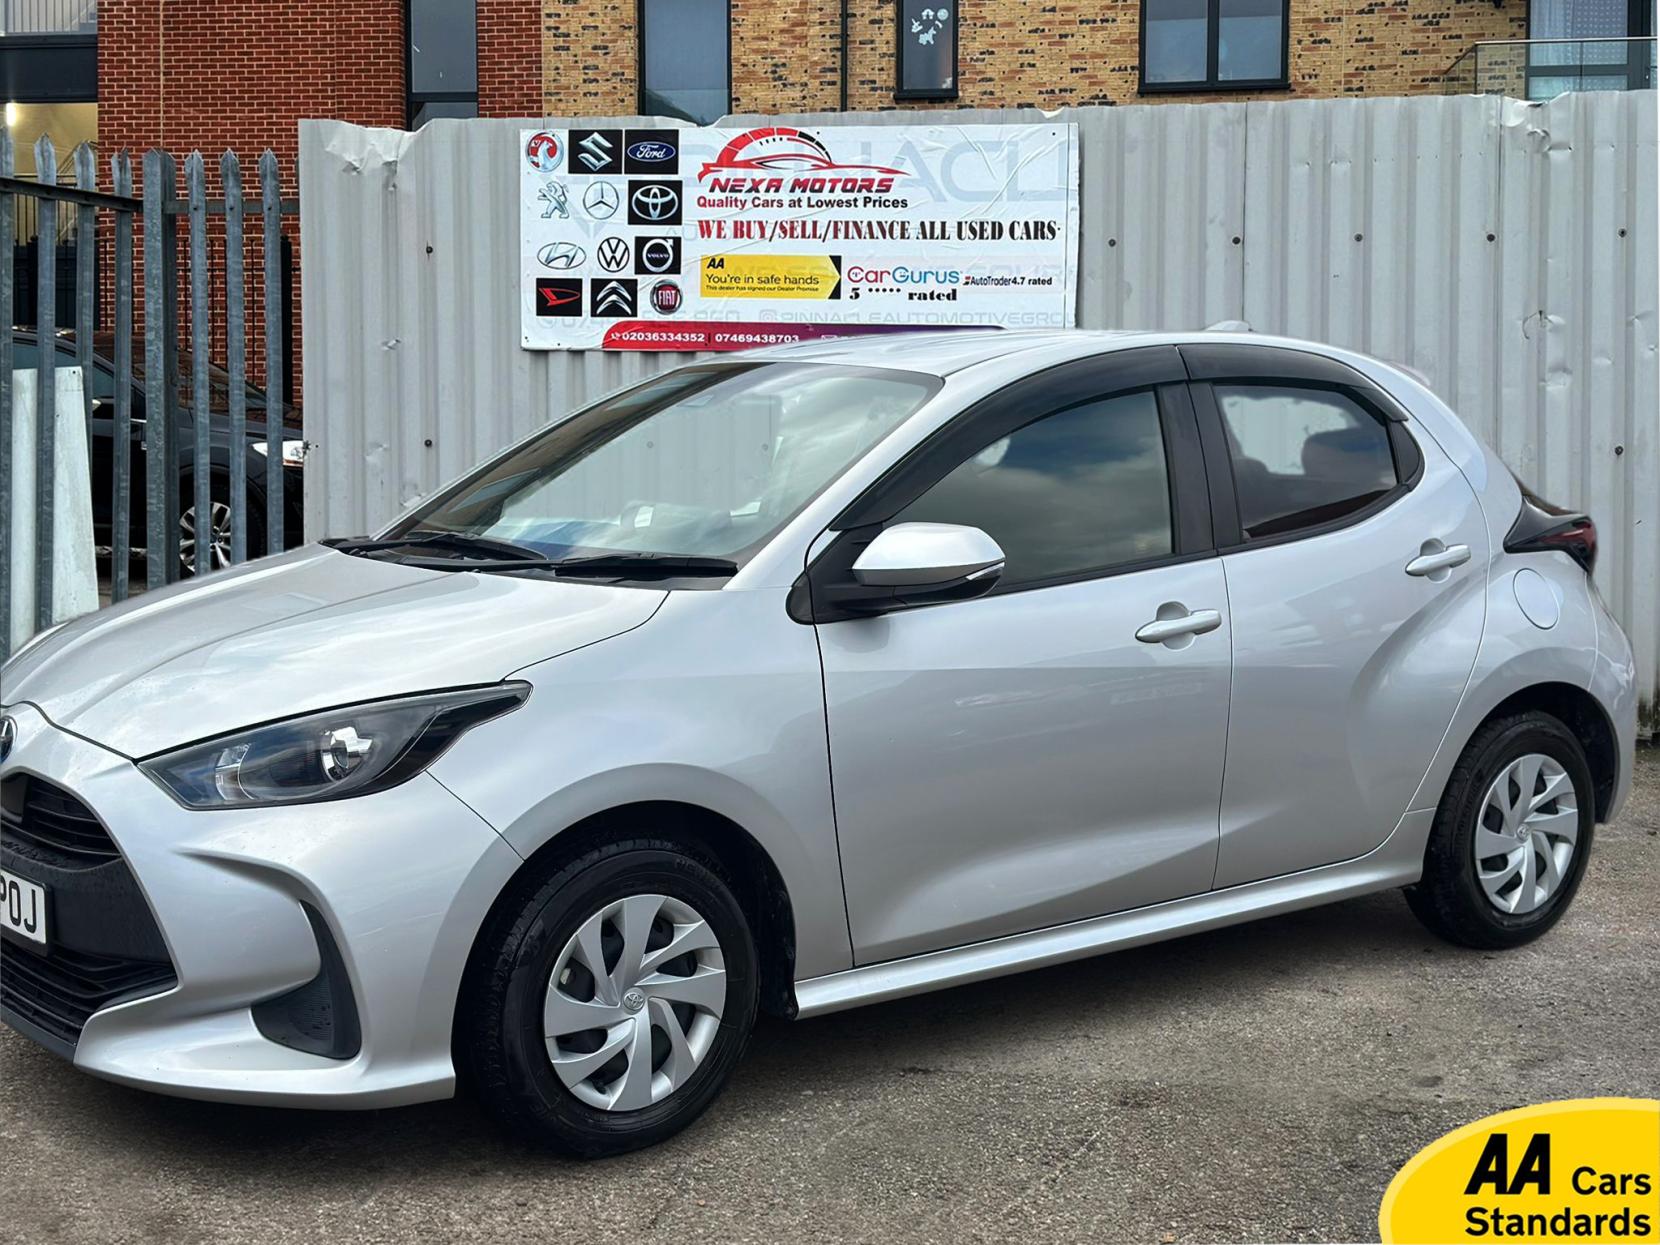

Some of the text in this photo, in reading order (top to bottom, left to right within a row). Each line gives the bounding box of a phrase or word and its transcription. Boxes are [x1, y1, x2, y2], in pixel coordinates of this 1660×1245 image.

[636, 144, 666, 159] Ford
[709, 177, 894, 194] NEXA MOTORS
[697, 196, 908, 210] Quality Cars at Lowest Prices
[697, 219, 726, 240] WE
[733, 219, 910, 242] BUY/SELL/FINANCE
[916, 220, 951, 240] ALL
[956, 220, 1004, 241] USED
[1008, 220, 1057, 241] CARS
[706, 257, 725, 269] AA
[706, 273, 820, 285] You're in safe hands
[847, 265, 960, 284] CarGurus
[1028, 276, 1053, 286] rated
[658, 290, 676, 305] FIAT
[849, 287, 958, 301] 5 rated
[621, 333, 800, 344] 02036334352 07469438703
